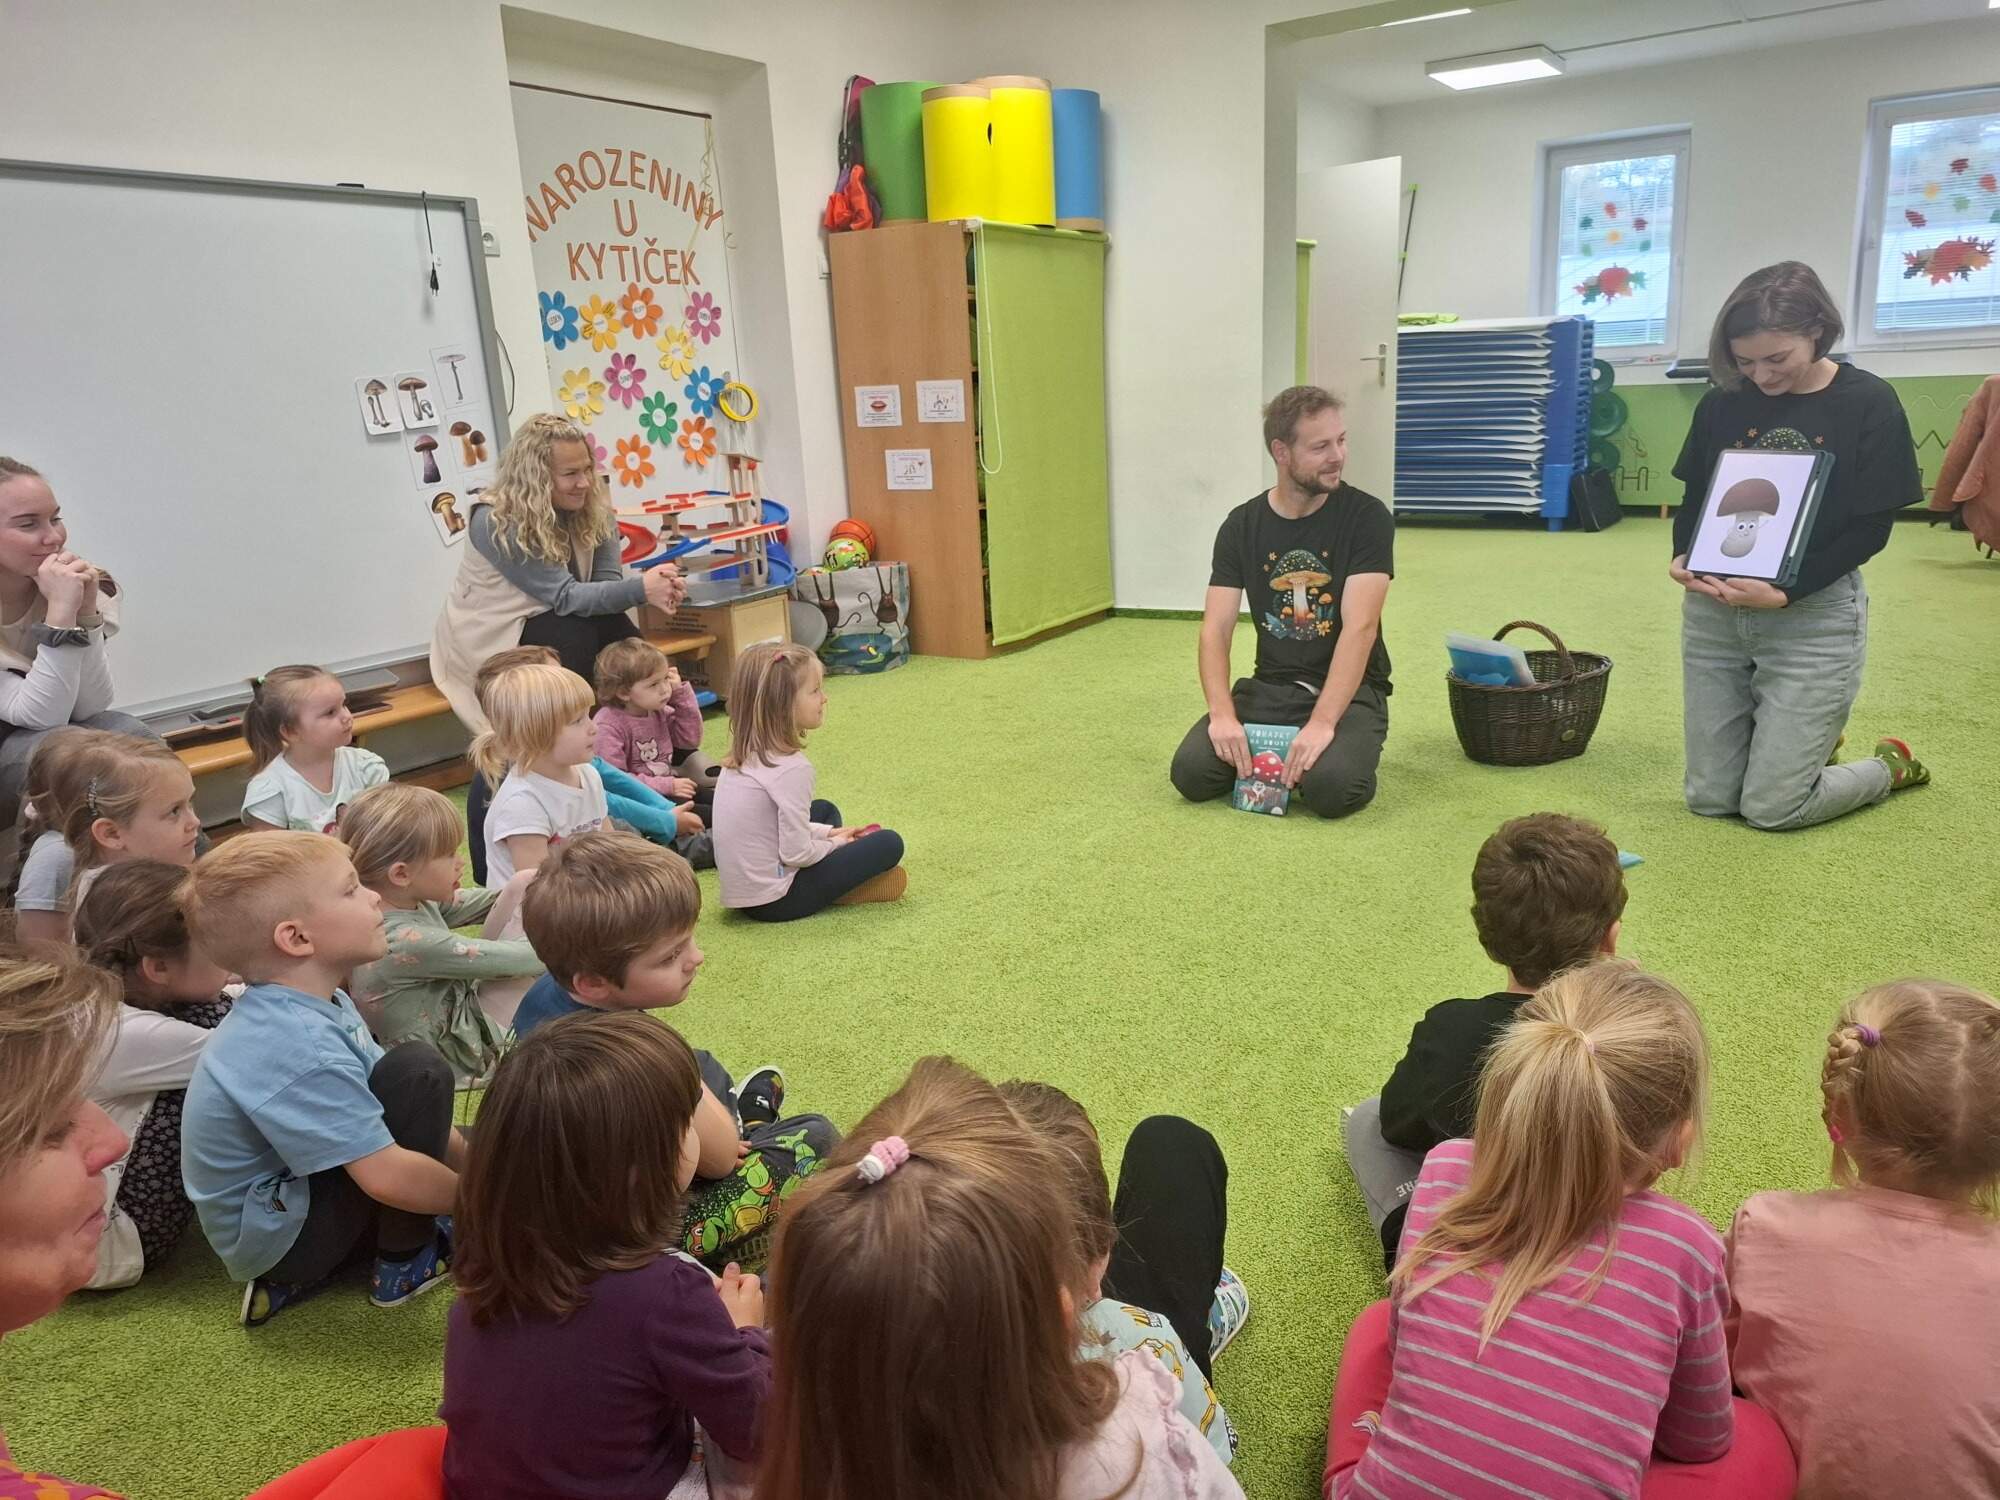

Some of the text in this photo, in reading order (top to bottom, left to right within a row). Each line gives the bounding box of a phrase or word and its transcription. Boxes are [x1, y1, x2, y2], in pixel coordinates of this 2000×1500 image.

[526, 148, 724, 242] NAROZENINY
[613, 199, 639, 237] U
[566, 237, 701, 286] KYTIČEK
